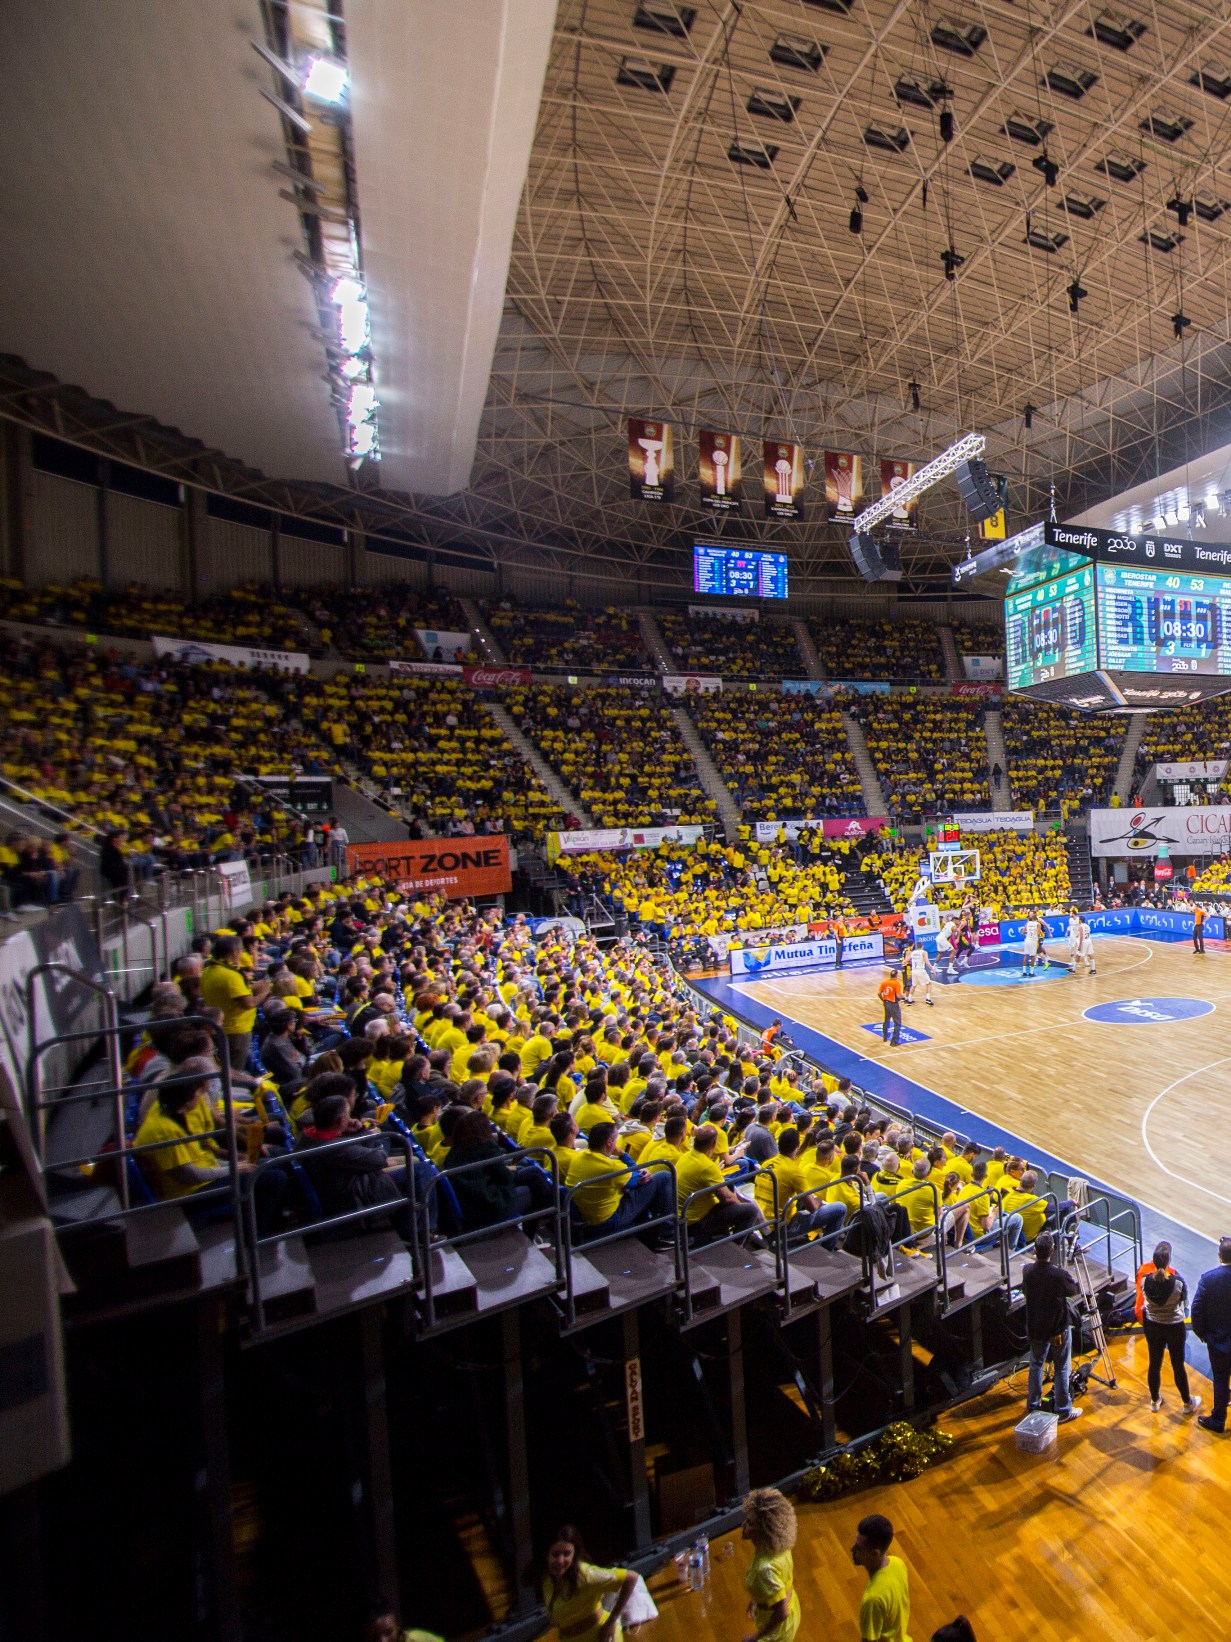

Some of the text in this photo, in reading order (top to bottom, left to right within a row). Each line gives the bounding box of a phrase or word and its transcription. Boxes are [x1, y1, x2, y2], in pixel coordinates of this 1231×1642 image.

[1053, 528, 1137, 553] Tenerife 2030
[1163, 543, 1183, 554] DXT
[729, 571, 753, 580] 08:30
[1121, 571, 1157, 581] IBEROSTAR
[1124, 579, 1155, 589] TENERIFE
[1165, 576, 1205, 591] 40 53
[1163, 620, 1205, 638] 08:30
[1035, 628, 1058, 648] 08:30
[1165, 641, 1176, 655] 3
[1201, 643, 1207, 657] 1
[1036, 652, 1043, 666] 3
[619, 677, 656, 686] INCOCAN
[945, 831, 959, 842] 24
[1186, 835, 1208, 845] Canary
[419, 850, 503, 874] ZONE
[774, 940, 874, 961] Mutua Tinrfeña
